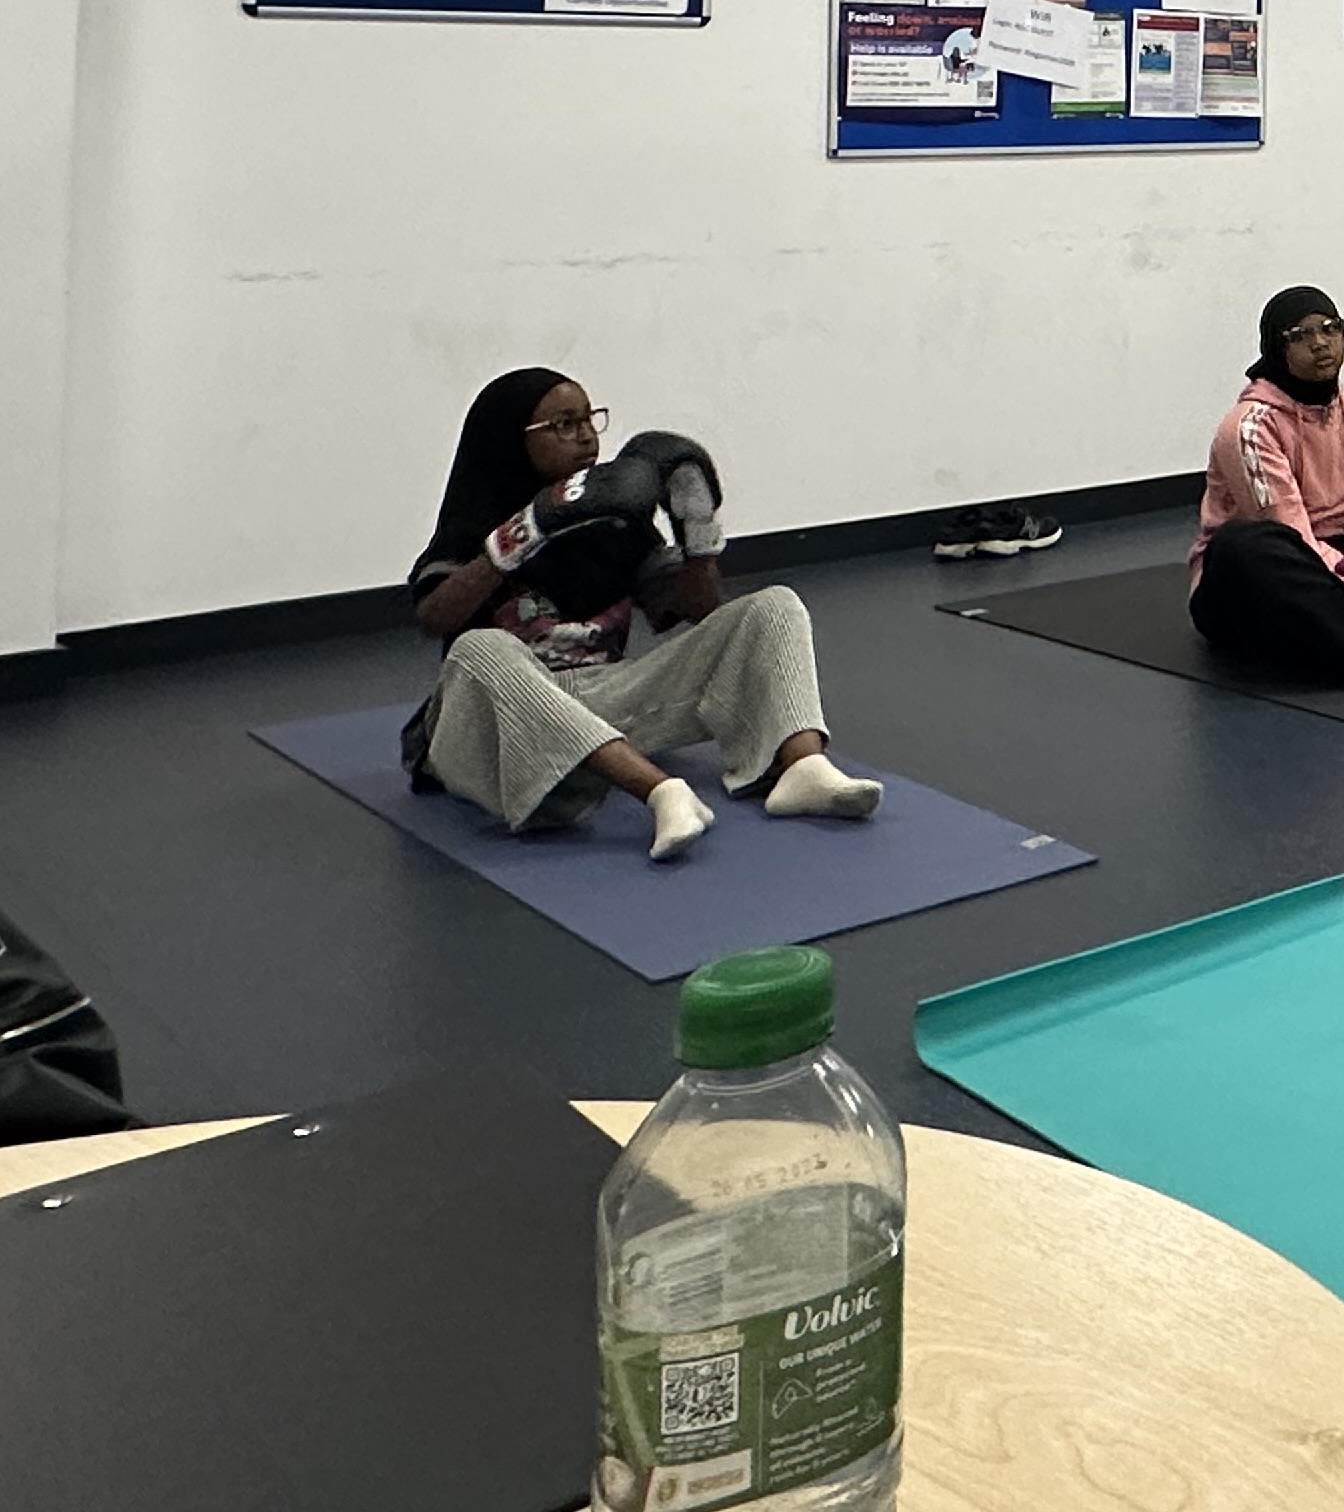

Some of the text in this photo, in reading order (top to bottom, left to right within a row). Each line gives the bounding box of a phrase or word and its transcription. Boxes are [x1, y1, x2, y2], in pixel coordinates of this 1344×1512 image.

[848, 11, 894, 25] Feeling
[850, 44, 875, 55] Help
[877, 44, 886, 53] is
[784, 1287, 879, 1340] Volvic
